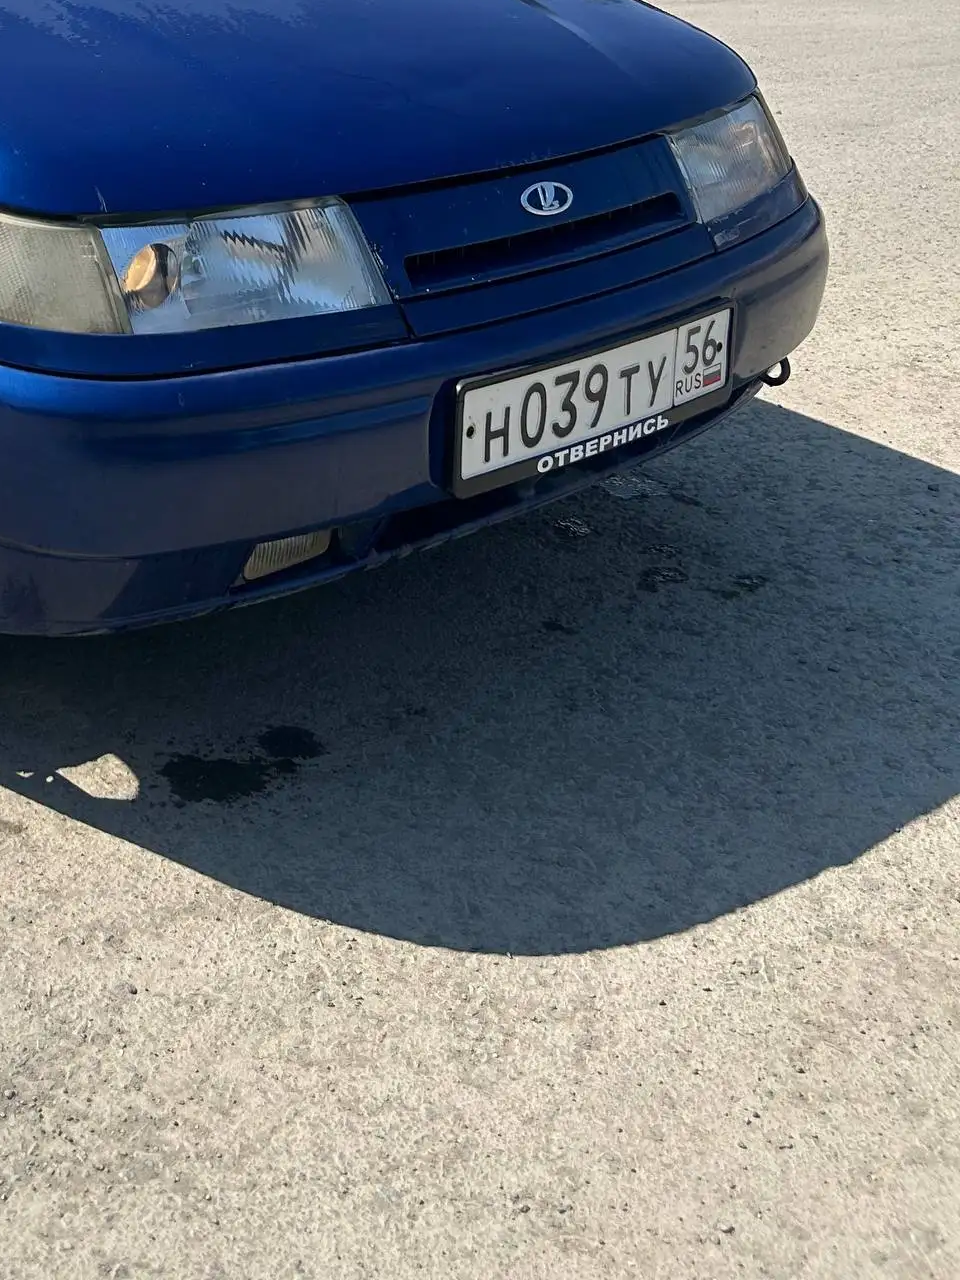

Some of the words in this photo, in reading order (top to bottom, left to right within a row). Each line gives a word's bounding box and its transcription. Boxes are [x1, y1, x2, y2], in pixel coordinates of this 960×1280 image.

[683, 320, 717, 374] 56
[675, 373, 702, 398] RUS
[536, 415, 669, 474] ОТВЕРНИСЬ
